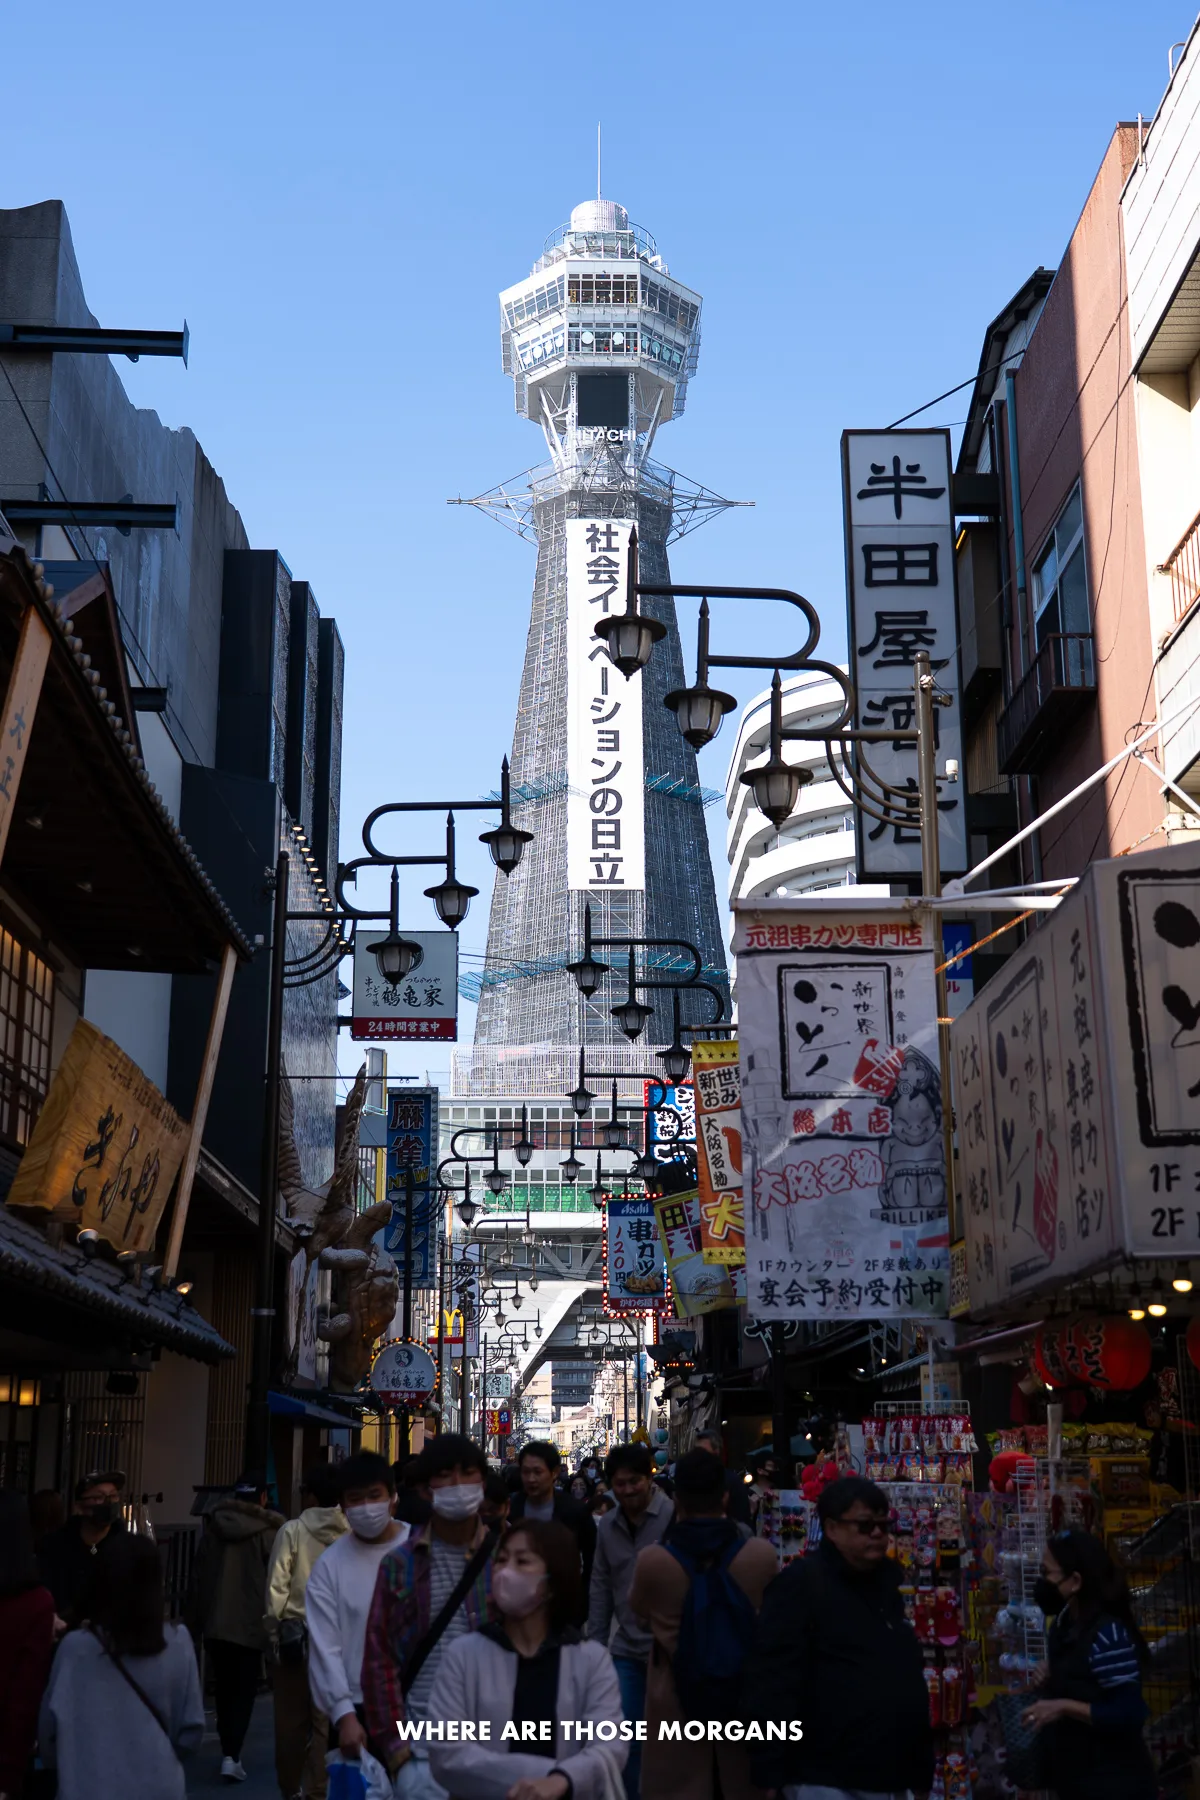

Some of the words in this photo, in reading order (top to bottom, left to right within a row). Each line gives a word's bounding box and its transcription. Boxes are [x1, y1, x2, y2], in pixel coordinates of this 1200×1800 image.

[572, 430, 636, 441] HITACHI
[857, 456, 958, 843] 半田屋酒店
[586, 523, 624, 884] 社会イベーションの日立
[745, 923, 923, 948] 元祖串カツ専門店
[382, 985, 444, 1007] 鶴亀家
[852, 980, 878, 1036] 新世界
[368, 1021, 440, 1033] 24時間営業中
[388, 1096, 425, 1168] 麻雀
[793, 1107, 891, 1135] 総本店
[704, 1117, 728, 1187] 大阪名物
[388, 1165, 430, 1190] NEW
[754, 1148, 885, 1211] 大阪名物
[1149, 1163, 1181, 1193] 1F
[621, 1203, 649, 1215] Asahi
[1151, 1208, 1184, 1237] 2F
[627, 1218, 656, 1277] 串カツ
[758, 1259, 850, 1273] 1Fカウンター
[864, 1257, 941, 1273] 2F座敷あり
[757, 1276, 944, 1308] 宴会予約受付中
